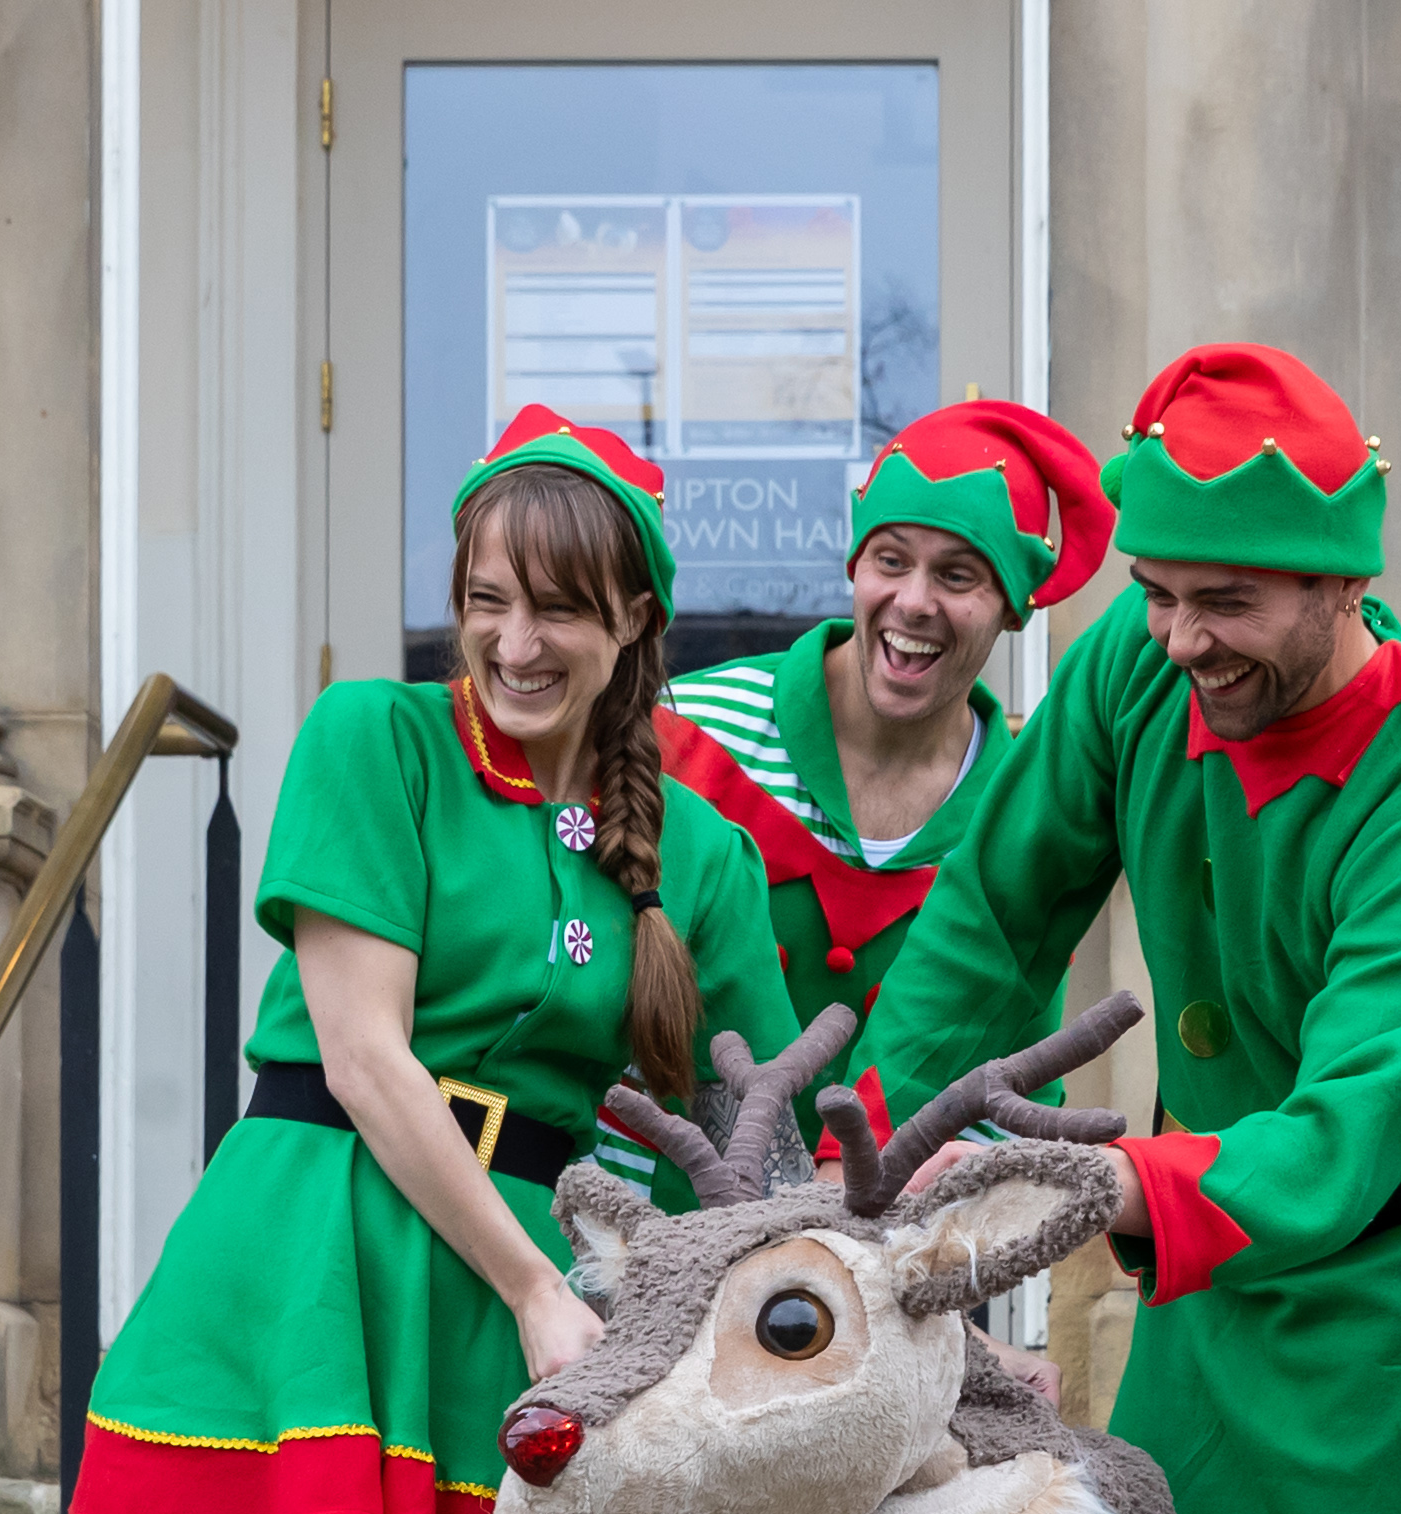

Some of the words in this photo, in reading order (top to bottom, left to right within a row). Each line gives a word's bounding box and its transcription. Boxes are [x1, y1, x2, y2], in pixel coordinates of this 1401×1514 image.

[664, 478, 798, 511] IPTON
[663, 517, 759, 550] OWN
[775, 517, 848, 550] HAL
